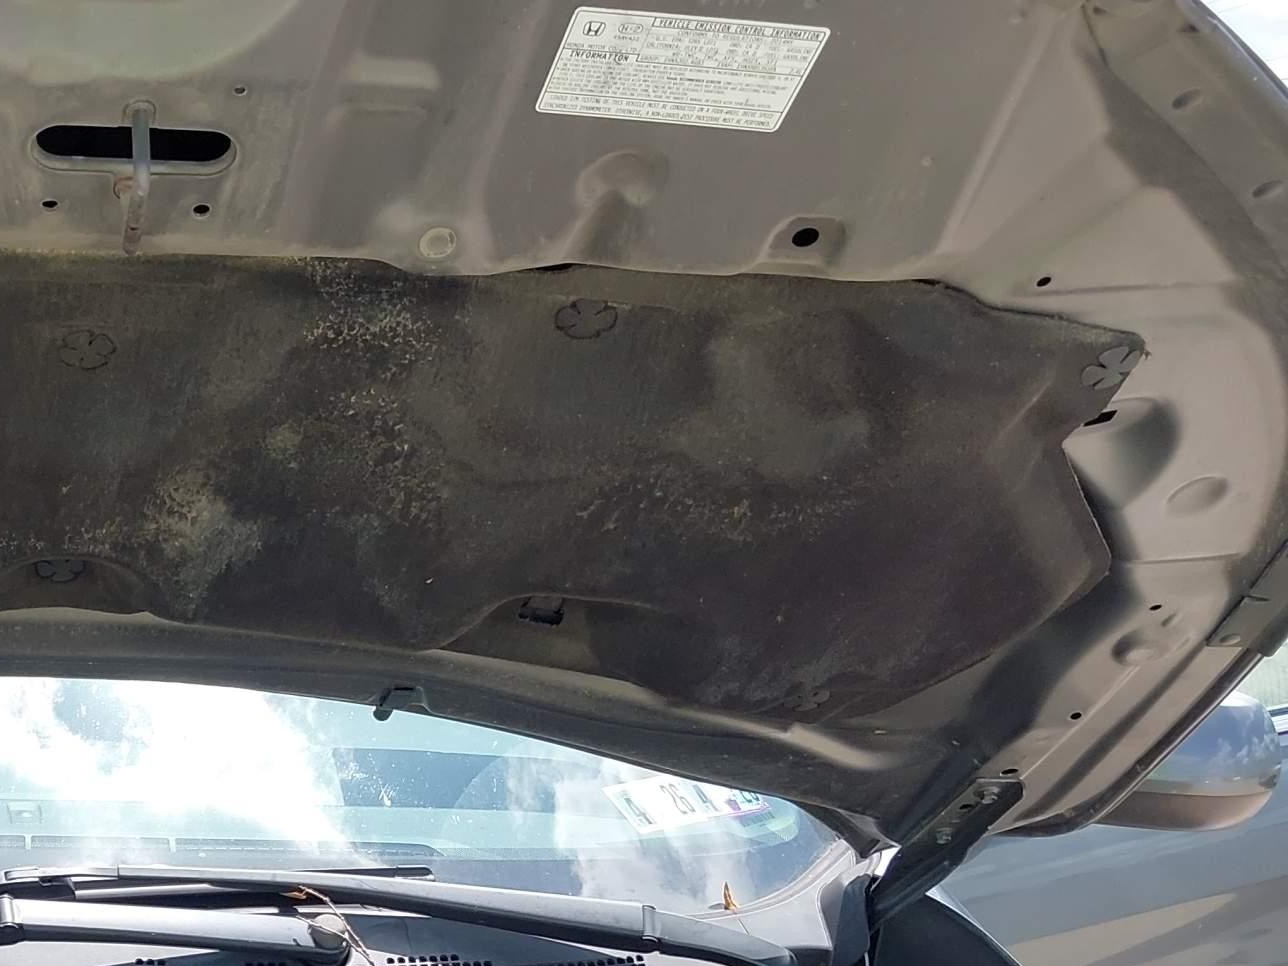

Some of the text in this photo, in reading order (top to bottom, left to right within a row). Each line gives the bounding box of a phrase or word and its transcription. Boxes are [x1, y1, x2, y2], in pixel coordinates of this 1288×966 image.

[658, 19, 821, 40] VEHICLE EMISSION CONTROL INFORMATION
[569, 51, 630, 62] INFORMATION
